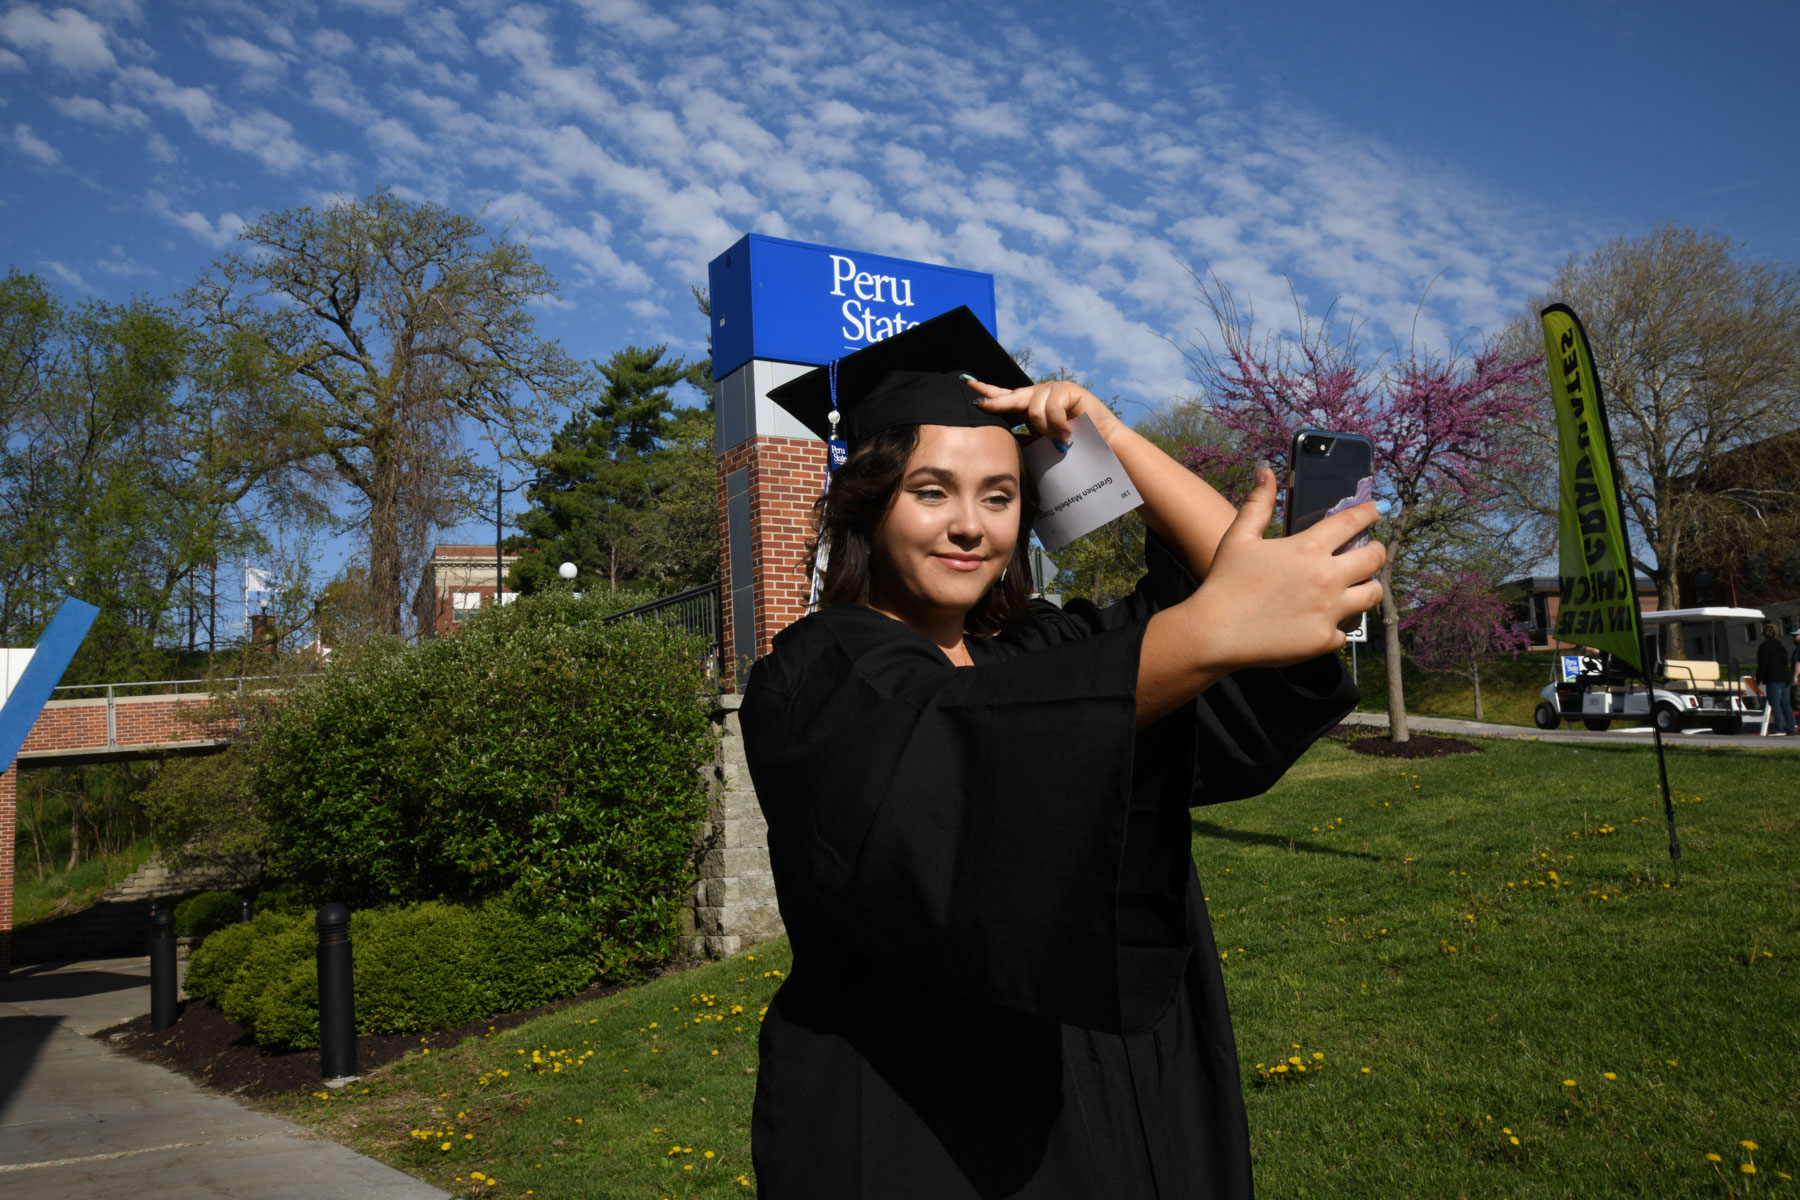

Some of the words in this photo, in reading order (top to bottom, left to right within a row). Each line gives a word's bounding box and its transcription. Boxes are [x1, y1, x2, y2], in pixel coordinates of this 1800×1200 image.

[829, 254, 915, 307] Peru
[841, 299, 921, 343] Stat
[831, 444, 846, 455] Peru
[1081, 476, 1113, 497] Gretchen
[1565, 658, 1577, 666] Peru
